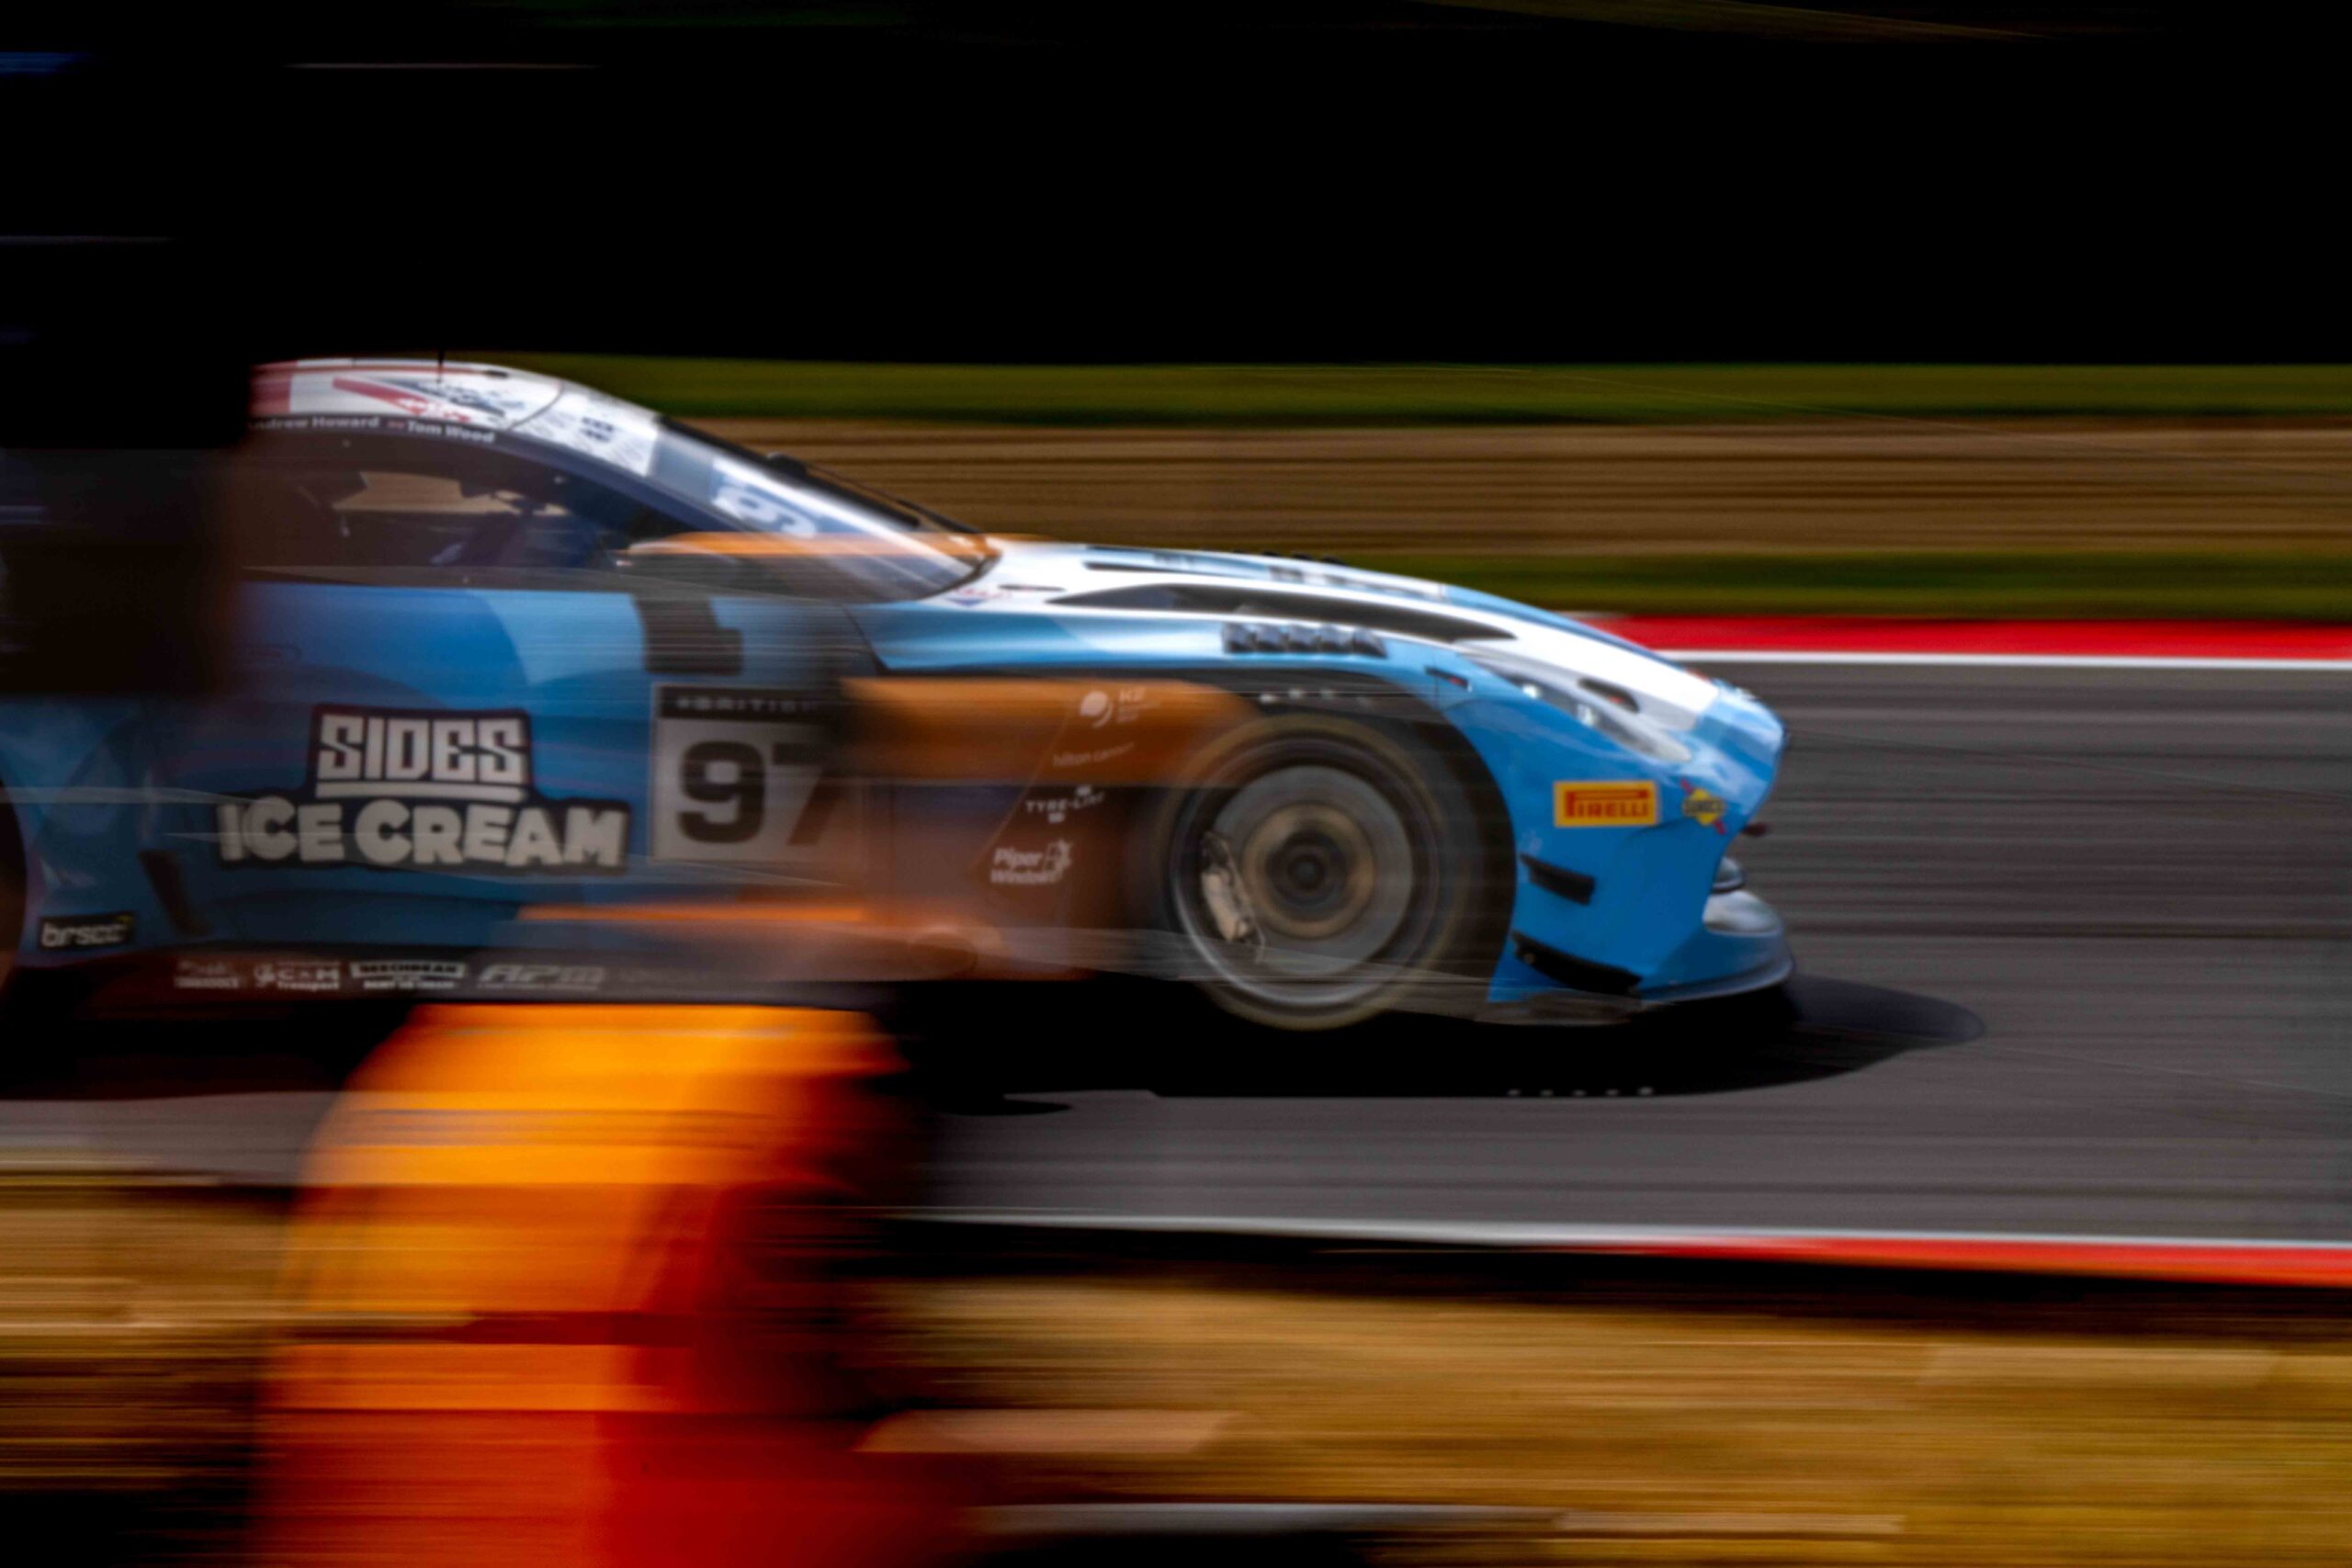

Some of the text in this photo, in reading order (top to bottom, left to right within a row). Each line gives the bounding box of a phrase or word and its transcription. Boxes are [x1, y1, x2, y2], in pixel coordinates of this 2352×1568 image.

[250, 416, 379, 429] ndrew Howard
[407, 420, 496, 444] Tom Wood
[316, 714, 525, 784] SIDES
[676, 740, 856, 846] 97
[1565, 790, 1648, 818] PIRELLI
[218, 795, 628, 867] ICE CREAM
